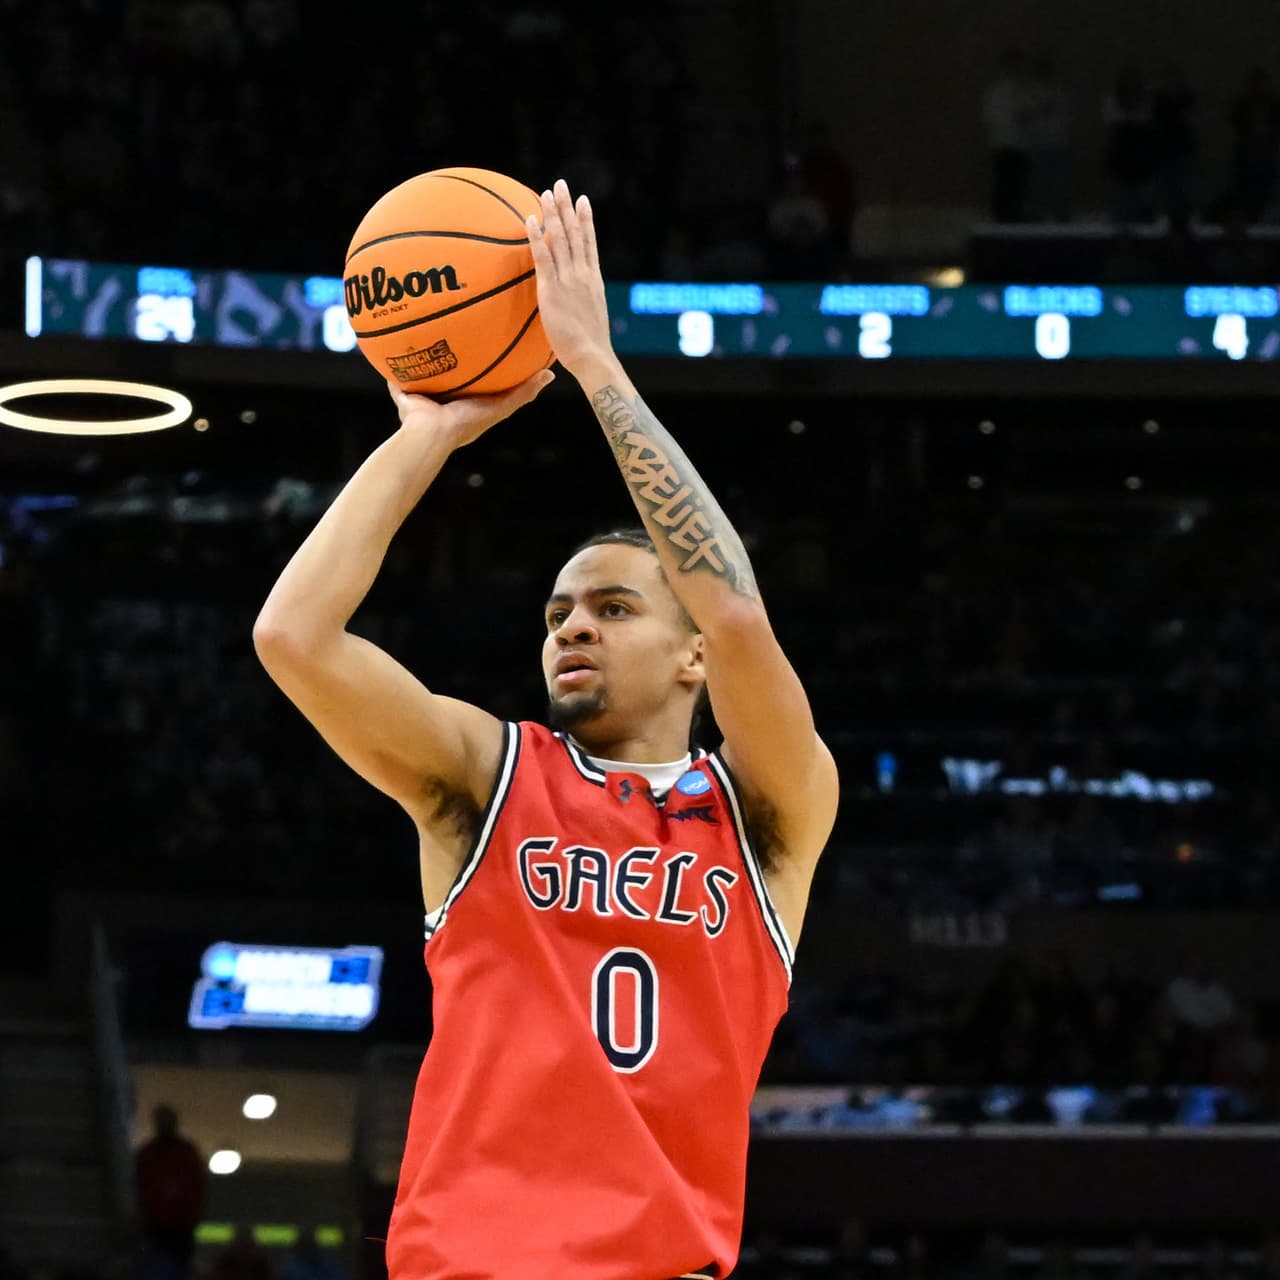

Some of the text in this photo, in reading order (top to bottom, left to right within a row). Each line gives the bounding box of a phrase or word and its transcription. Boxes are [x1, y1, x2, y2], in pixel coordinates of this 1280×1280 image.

[344, 265, 461, 318] Wilson
[858, 312, 892, 358] 2
[1035, 313, 1070, 359] 0
[1213, 313, 1249, 360] 4
[517, 837, 738, 938] GAELS
[591, 946, 658, 1074] 0
